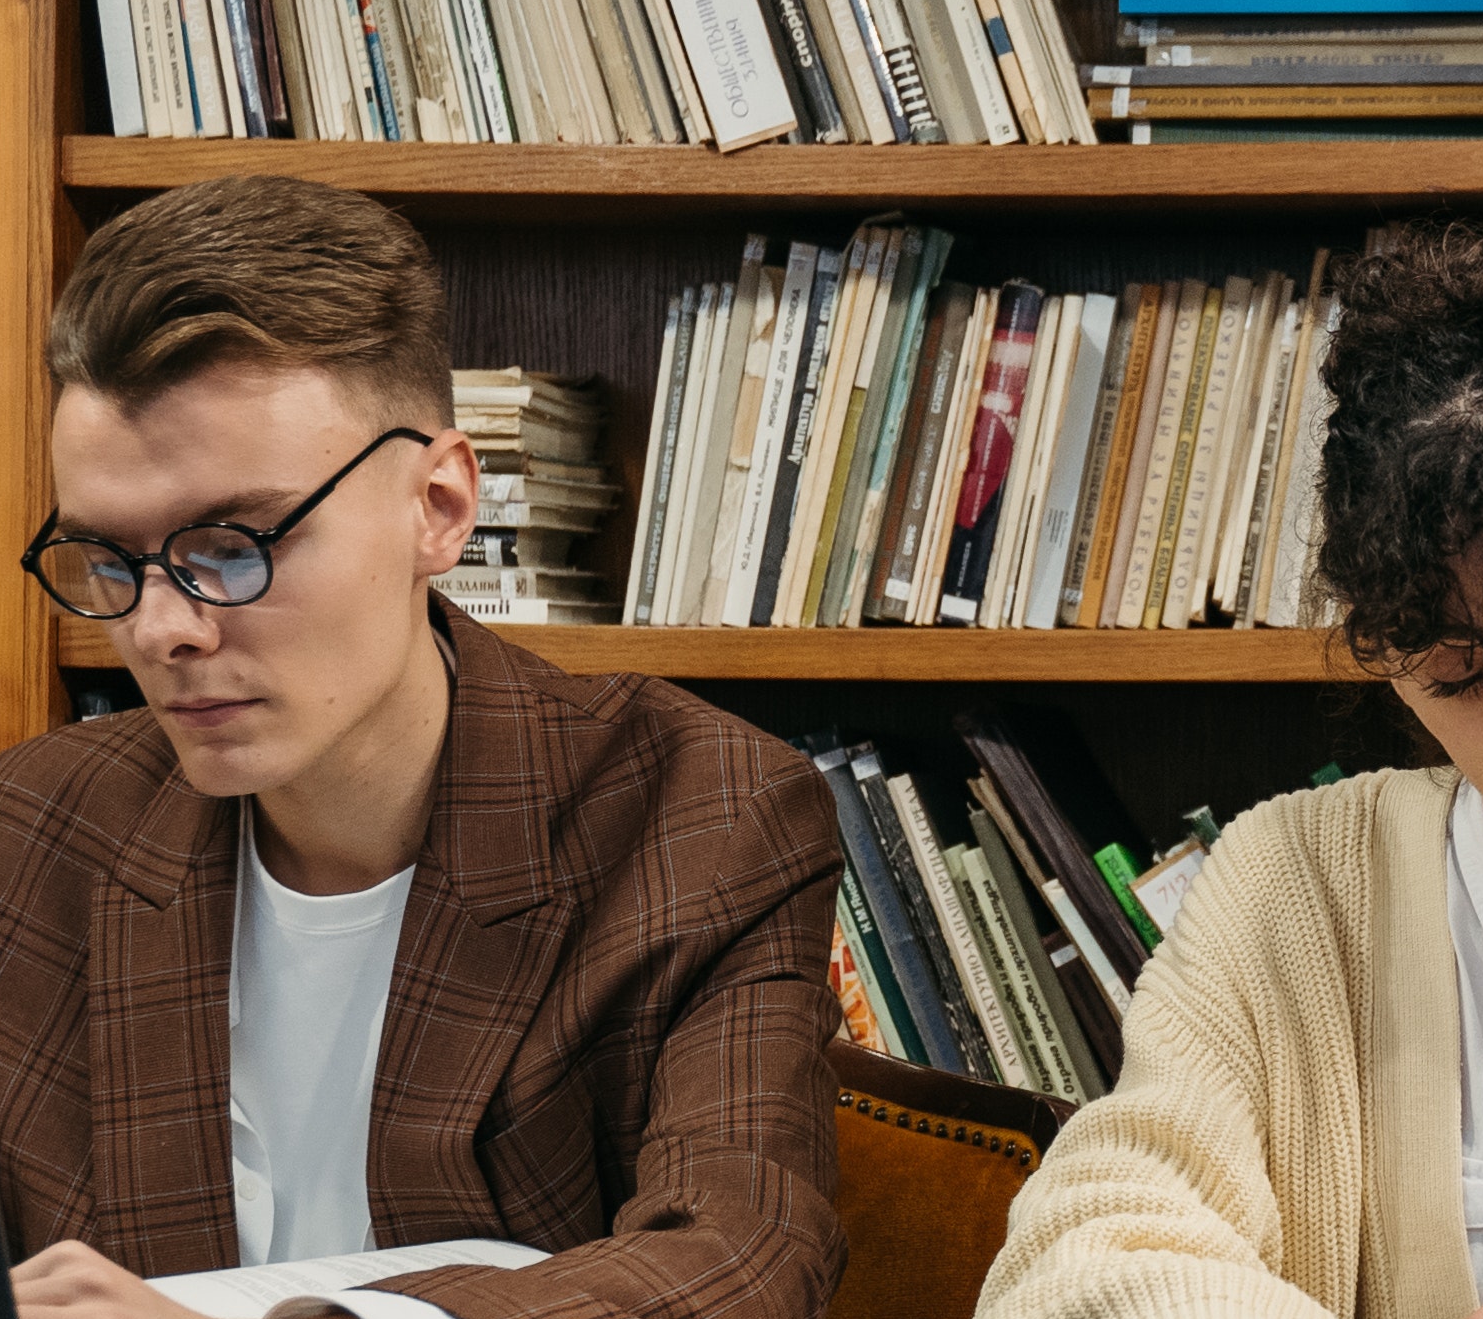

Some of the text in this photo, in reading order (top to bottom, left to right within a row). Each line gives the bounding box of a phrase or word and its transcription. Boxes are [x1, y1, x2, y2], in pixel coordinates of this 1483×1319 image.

[724, 17, 758, 84] ЗДАНИЯ
[674, 313, 693, 379] ЗДАНИ
[781, 286, 804, 346] ЧЕЛОВЕКА
[775, 349, 791, 373] ДЛЯ
[764, 376, 785, 428] ЖИЛИЩЕ
[903, 782, 932, 833] СРЕДА
[960, 877, 1007, 973] архитектура
[980, 877, 1027, 973] архитектура
[1002, 981, 1035, 1043] природы
[1023, 982, 1056, 1044] природы
[1026, 1042, 1055, 1094] Охрана
[1047, 1043, 1076, 1095] Охрана
